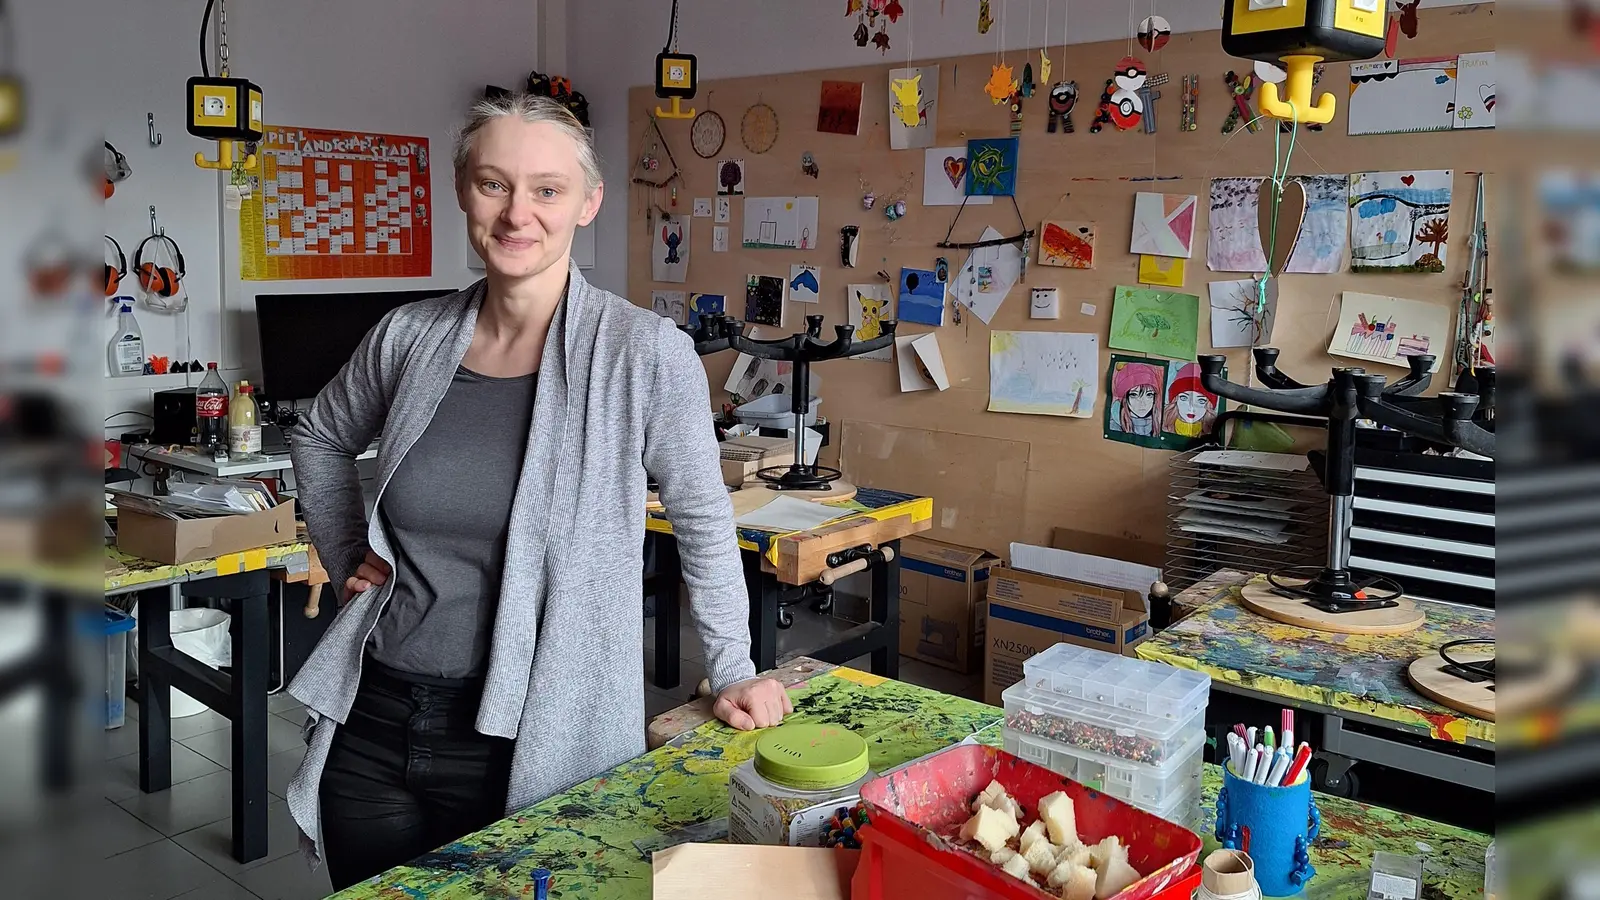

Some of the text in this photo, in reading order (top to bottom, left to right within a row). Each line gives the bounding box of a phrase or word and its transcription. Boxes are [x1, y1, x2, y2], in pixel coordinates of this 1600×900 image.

[294, 135, 373, 154] LANDSCHAFT
[371, 142, 417, 158] STADT
[731, 778, 750, 800] PYSSLA
